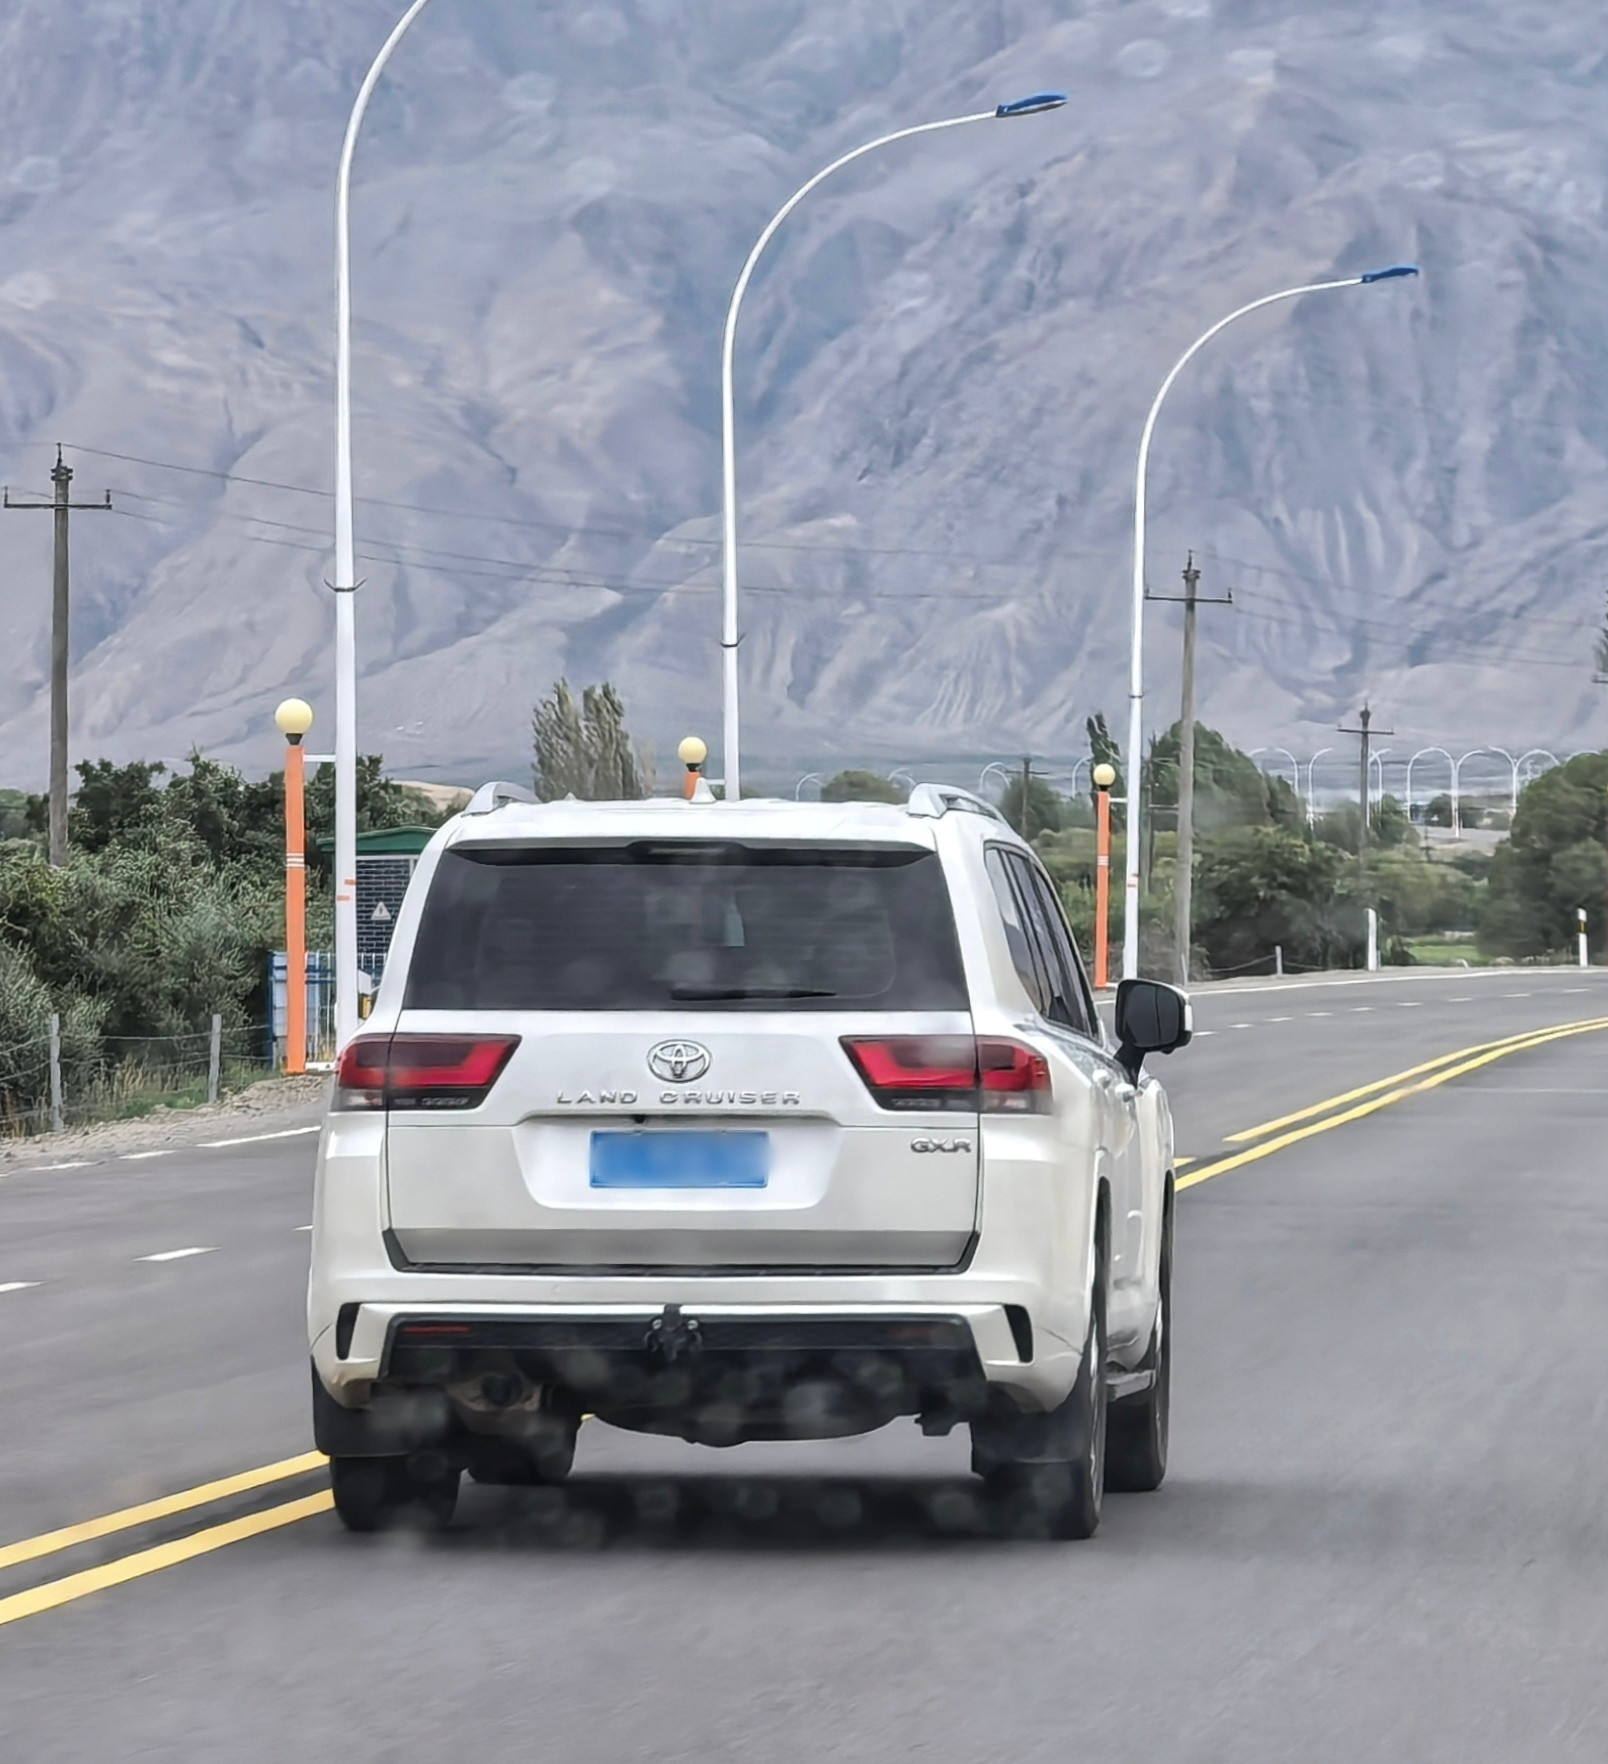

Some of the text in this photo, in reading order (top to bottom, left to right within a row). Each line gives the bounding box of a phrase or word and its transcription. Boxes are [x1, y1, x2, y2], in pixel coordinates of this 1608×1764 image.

[557, 1089, 801, 1105] LAND CRUISER
[910, 1137, 971, 1153] GXR
